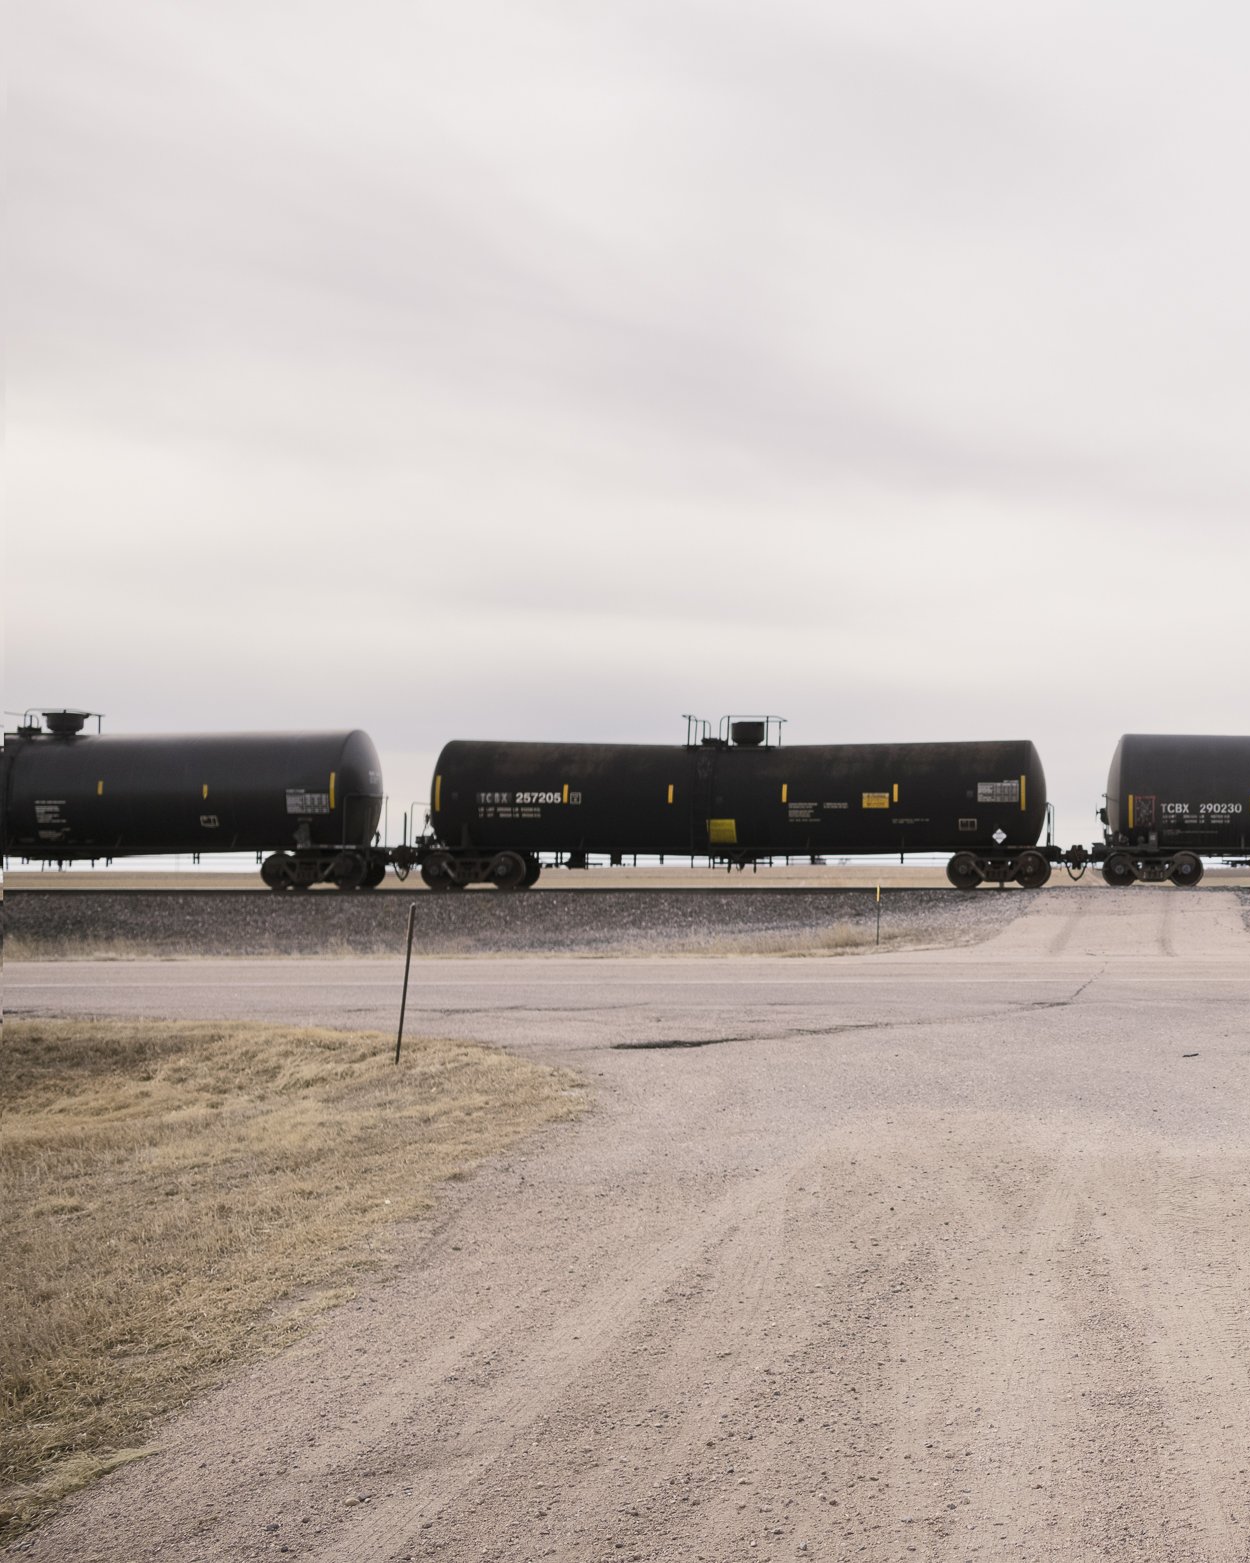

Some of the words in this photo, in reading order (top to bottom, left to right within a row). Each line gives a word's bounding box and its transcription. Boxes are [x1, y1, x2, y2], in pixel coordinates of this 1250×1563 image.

[480, 792, 508, 804] TCBX
[515, 792, 562, 804] 257205
[1160, 803, 1190, 814] TCBX
[1199, 803, 1242, 814] 290230
